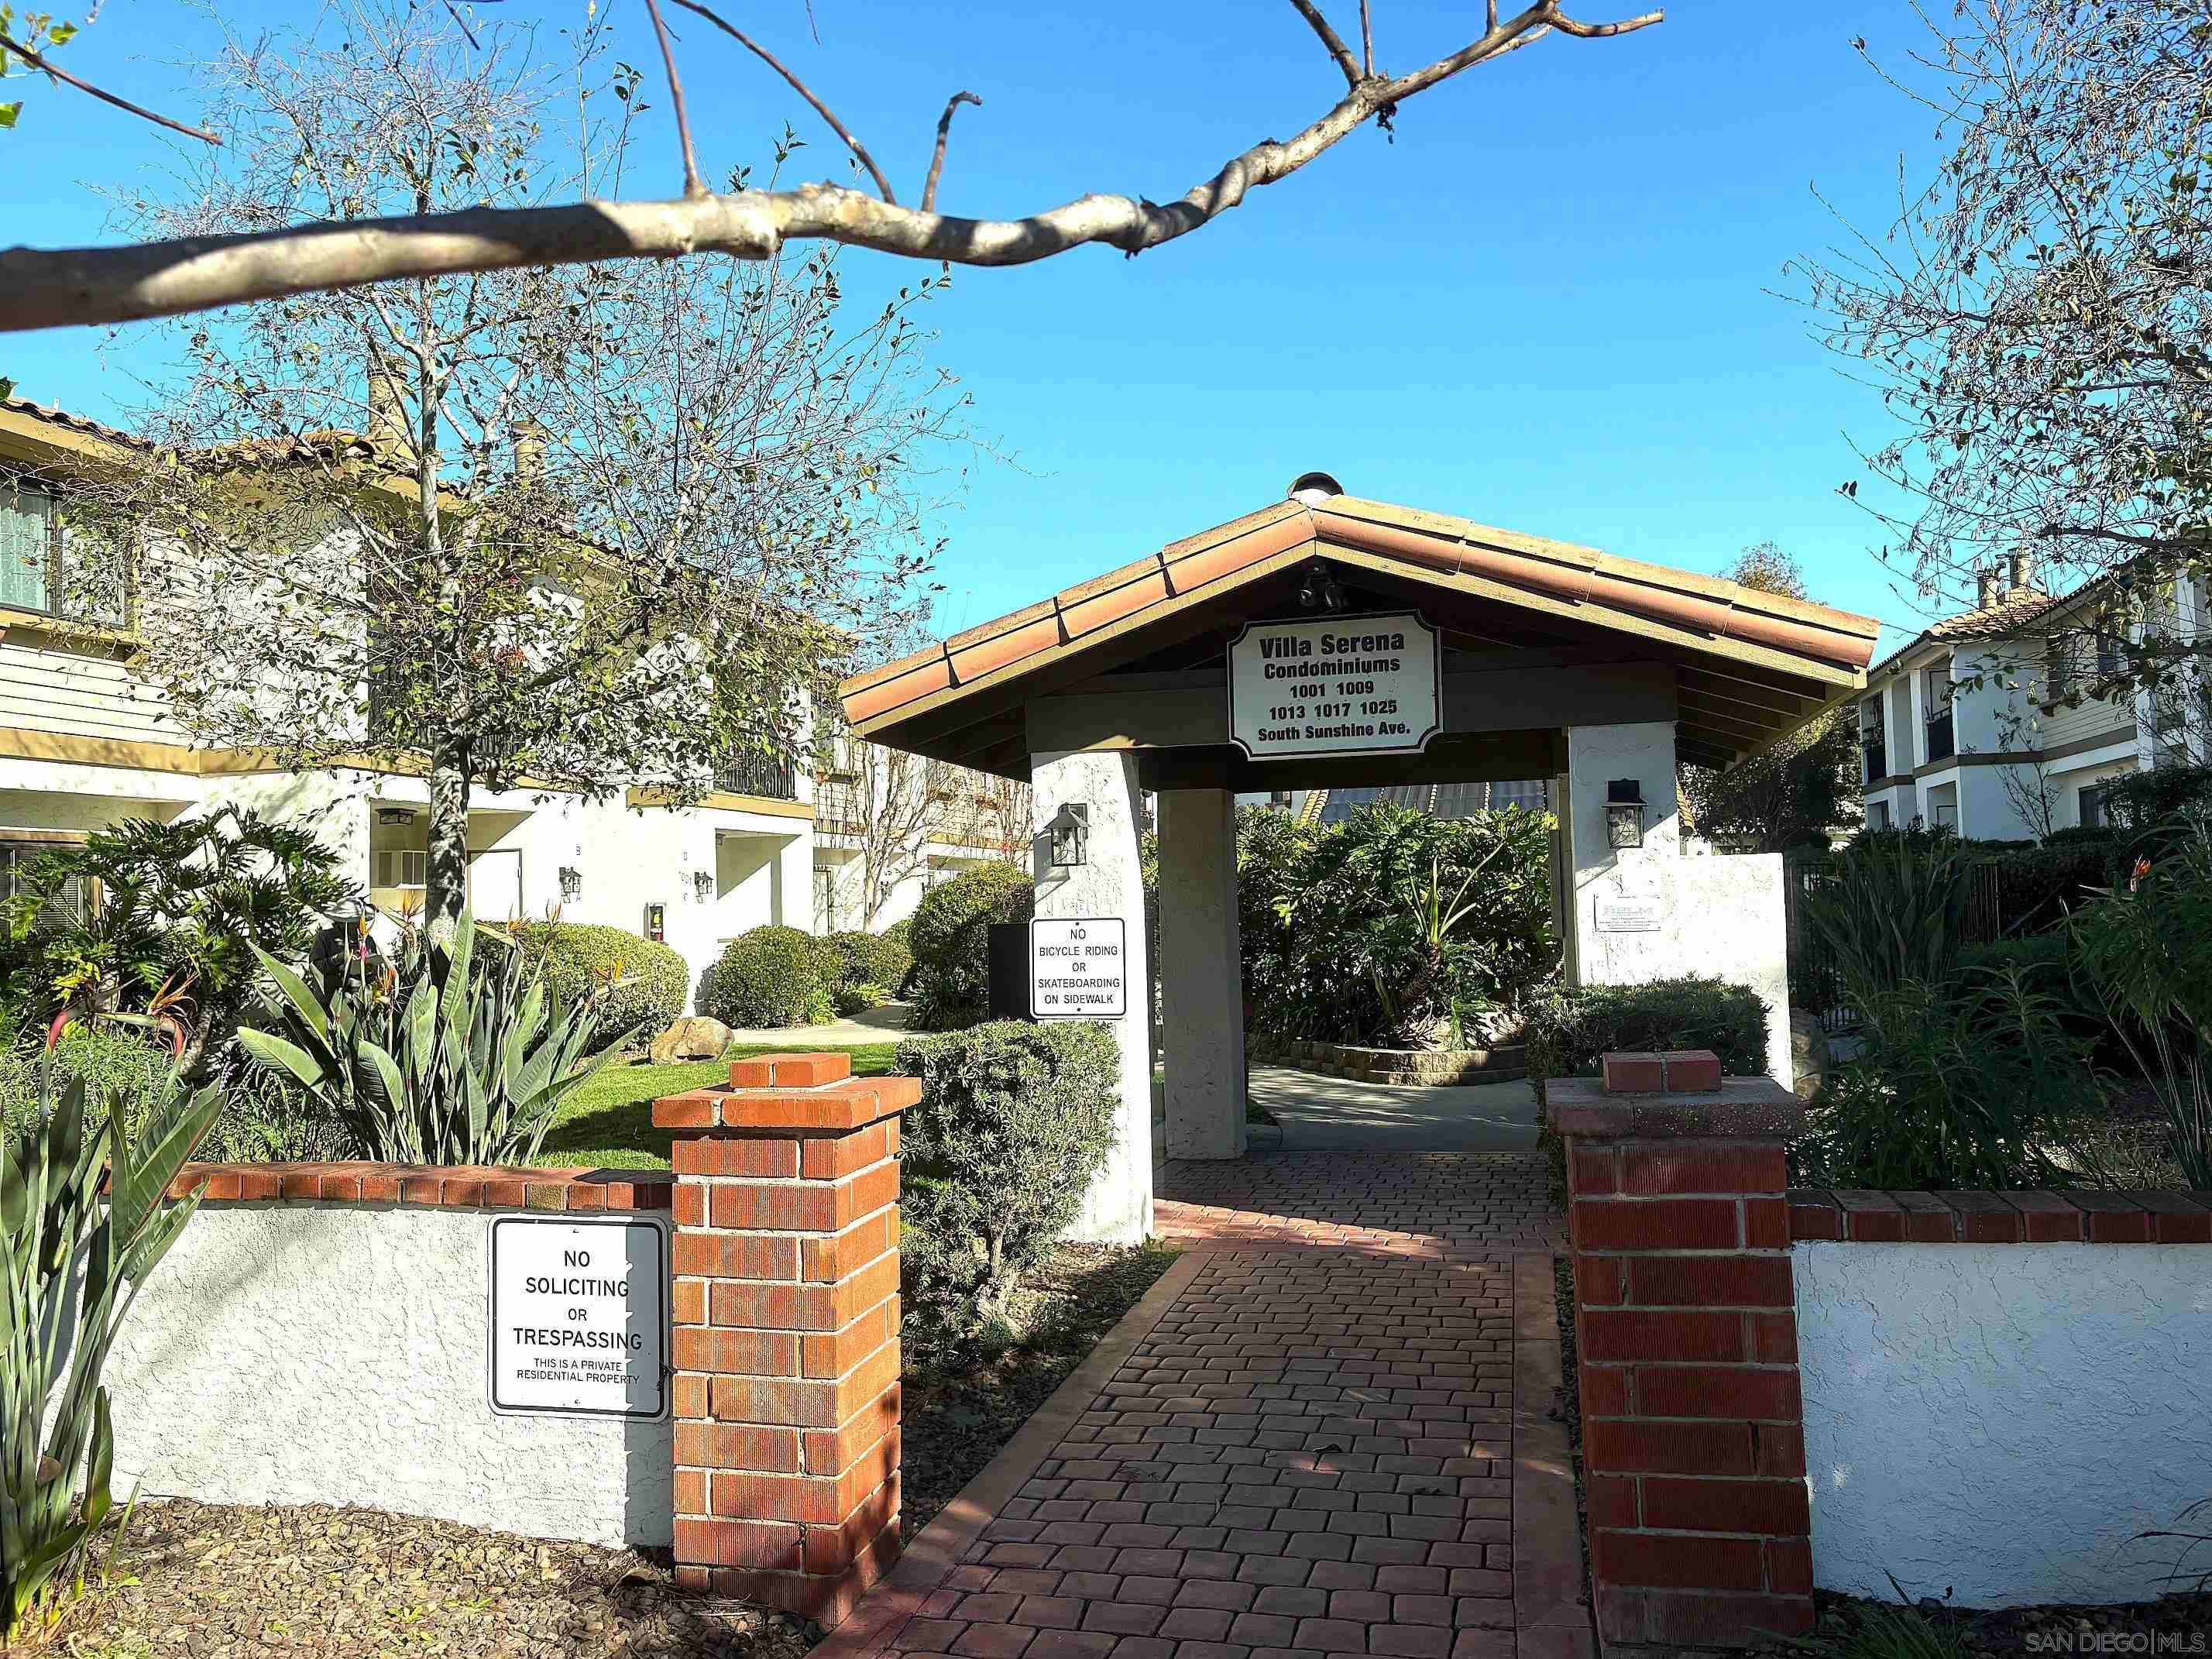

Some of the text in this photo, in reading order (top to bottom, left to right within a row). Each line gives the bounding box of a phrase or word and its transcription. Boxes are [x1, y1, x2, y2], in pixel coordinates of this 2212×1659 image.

[1259, 632, 1405, 660] Villa Serena
[1264, 657, 1401, 680] Condominiums
[1290, 680, 1375, 699] 1001 1009
[1269, 699, 1397, 720] 1013 1017 1025
[1258, 720, 1411, 742] South Sunshine Ave.
[1070, 929, 1086, 939] NO
[1039, 946, 1118, 957] BICYCLE RIDING
[1072, 962, 1086, 972] OR
[1038, 977, 1120, 988] SKATEBOARDING
[1044, 994, 1114, 1004] ON SIDEWALK
[564, 1250, 590, 1267] NO
[525, 1276, 629, 1297] SOLICITING
[568, 1308, 587, 1321] OR
[513, 1328, 642, 1350] TRESPASSING
[534, 1358, 623, 1371] THIS IS A PRIVATE
[517, 1369, 640, 1385] RESIDENTIAL PROPERTY
